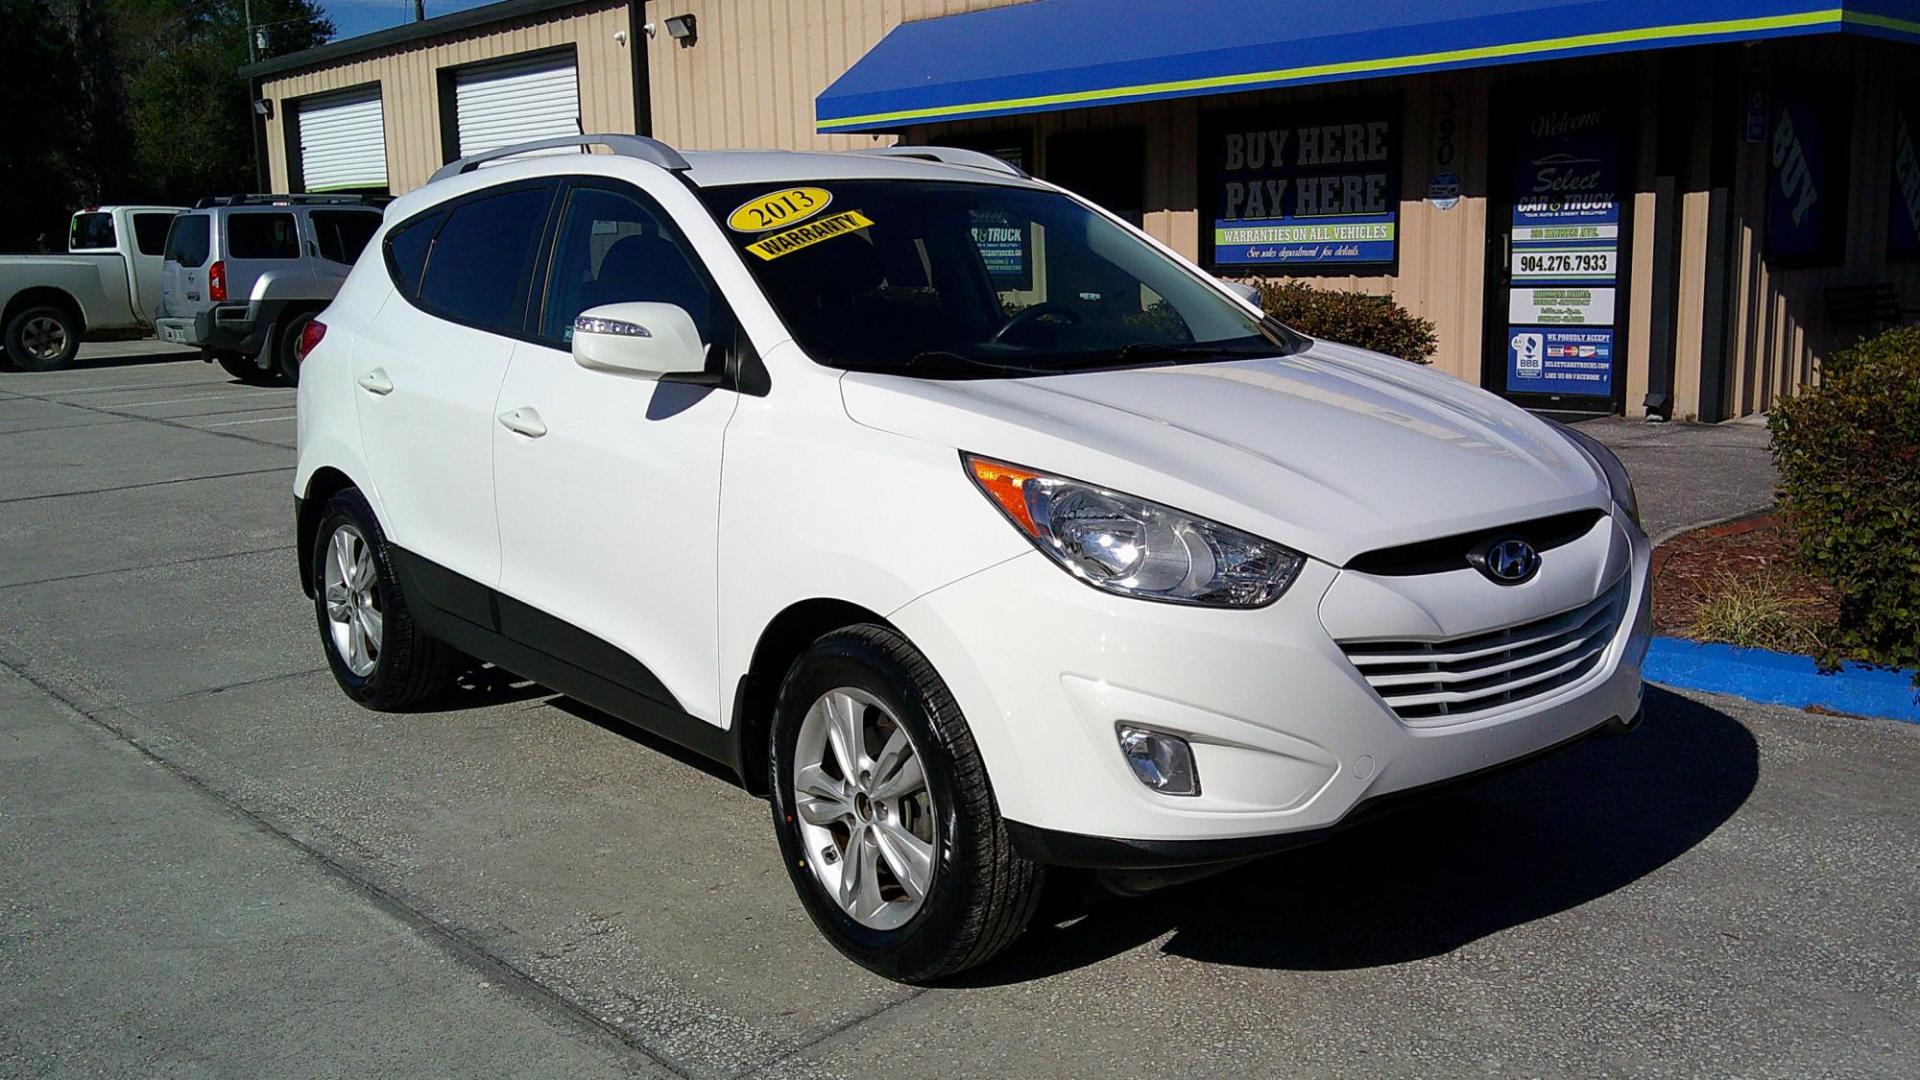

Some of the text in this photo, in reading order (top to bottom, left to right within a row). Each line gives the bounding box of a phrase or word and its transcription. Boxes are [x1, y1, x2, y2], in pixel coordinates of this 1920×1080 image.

[1225, 122, 1388, 170] BUY HERE
[1773, 107, 1817, 228] BUY
[1532, 168, 1601, 192] Select
[1225, 178, 1288, 219] PAY
[1295, 173, 1387, 215] HERE
[1517, 195, 1547, 212] CAR
[1563, 192, 1615, 211] TRUCK
[749, 190, 814, 227] 2013
[757, 213, 858, 256] WARRANTY
[988, 228, 1022, 242] TRUCK
[1224, 225, 1387, 243] WARRANTIES ON ALL VEHICLES
[1246, 246, 1261, 258] See
[1261, 246, 1277, 258] sales
[1278, 246, 1318, 262] department
[1319, 245, 1333, 260] for
[1520, 254, 1607, 272] 904.276.7933
[1520, 359, 1539, 367] BBB
